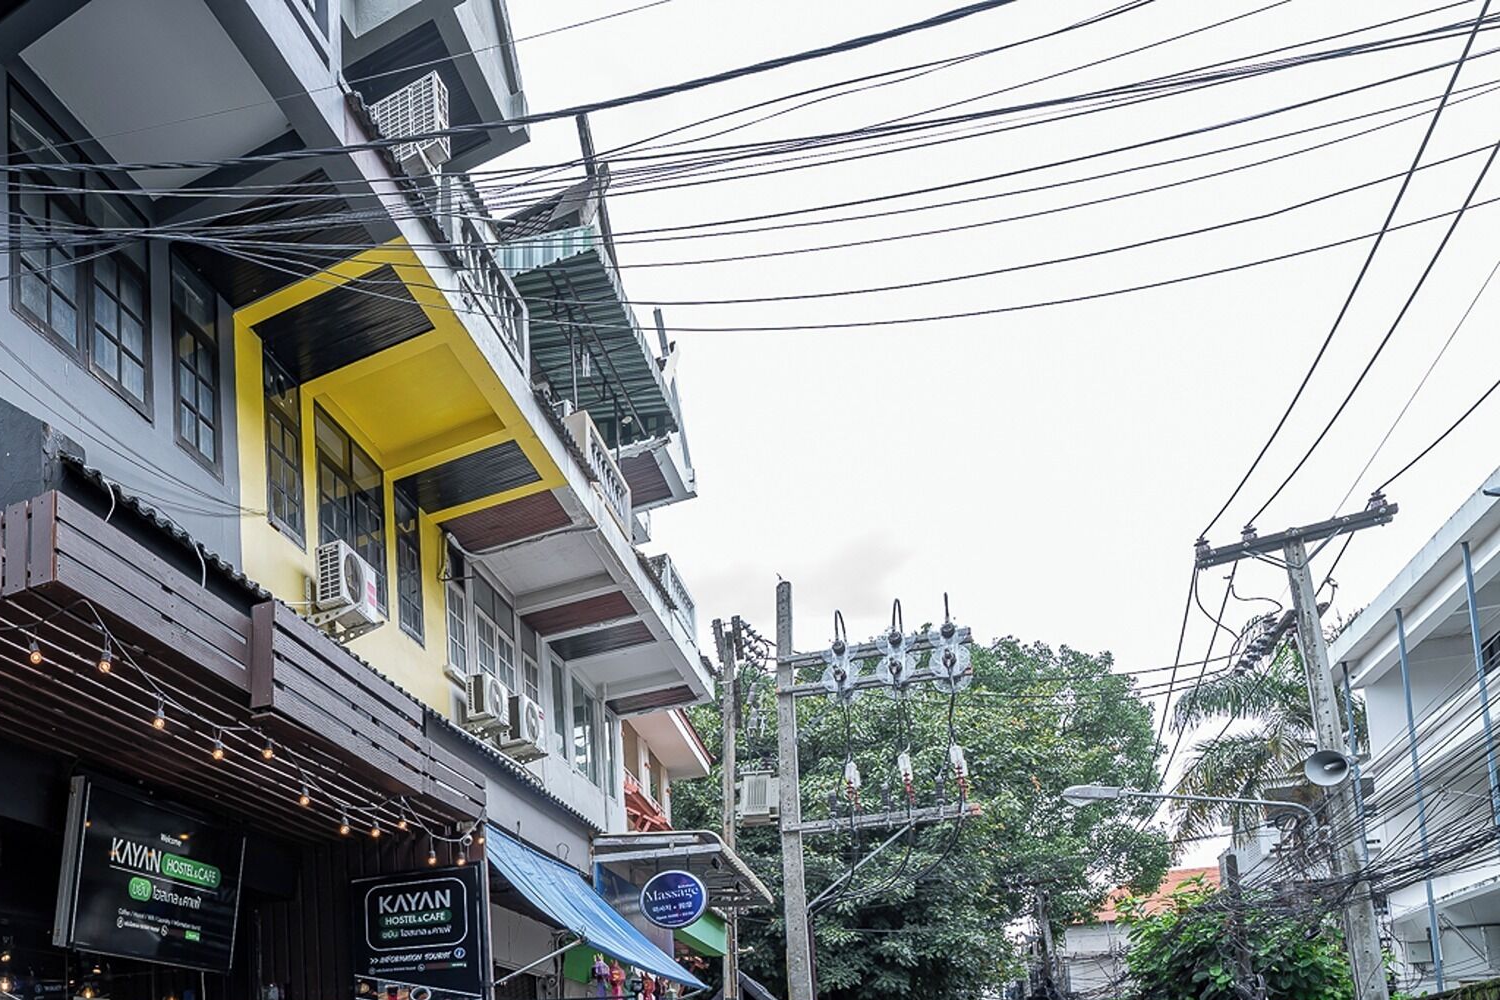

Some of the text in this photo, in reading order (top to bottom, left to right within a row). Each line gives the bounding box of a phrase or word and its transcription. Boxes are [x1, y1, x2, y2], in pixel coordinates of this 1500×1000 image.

[110, 837, 162, 873] KAYAN
[379, 889, 451, 914] KAYAN
[645, 886, 699, 902] Massage
